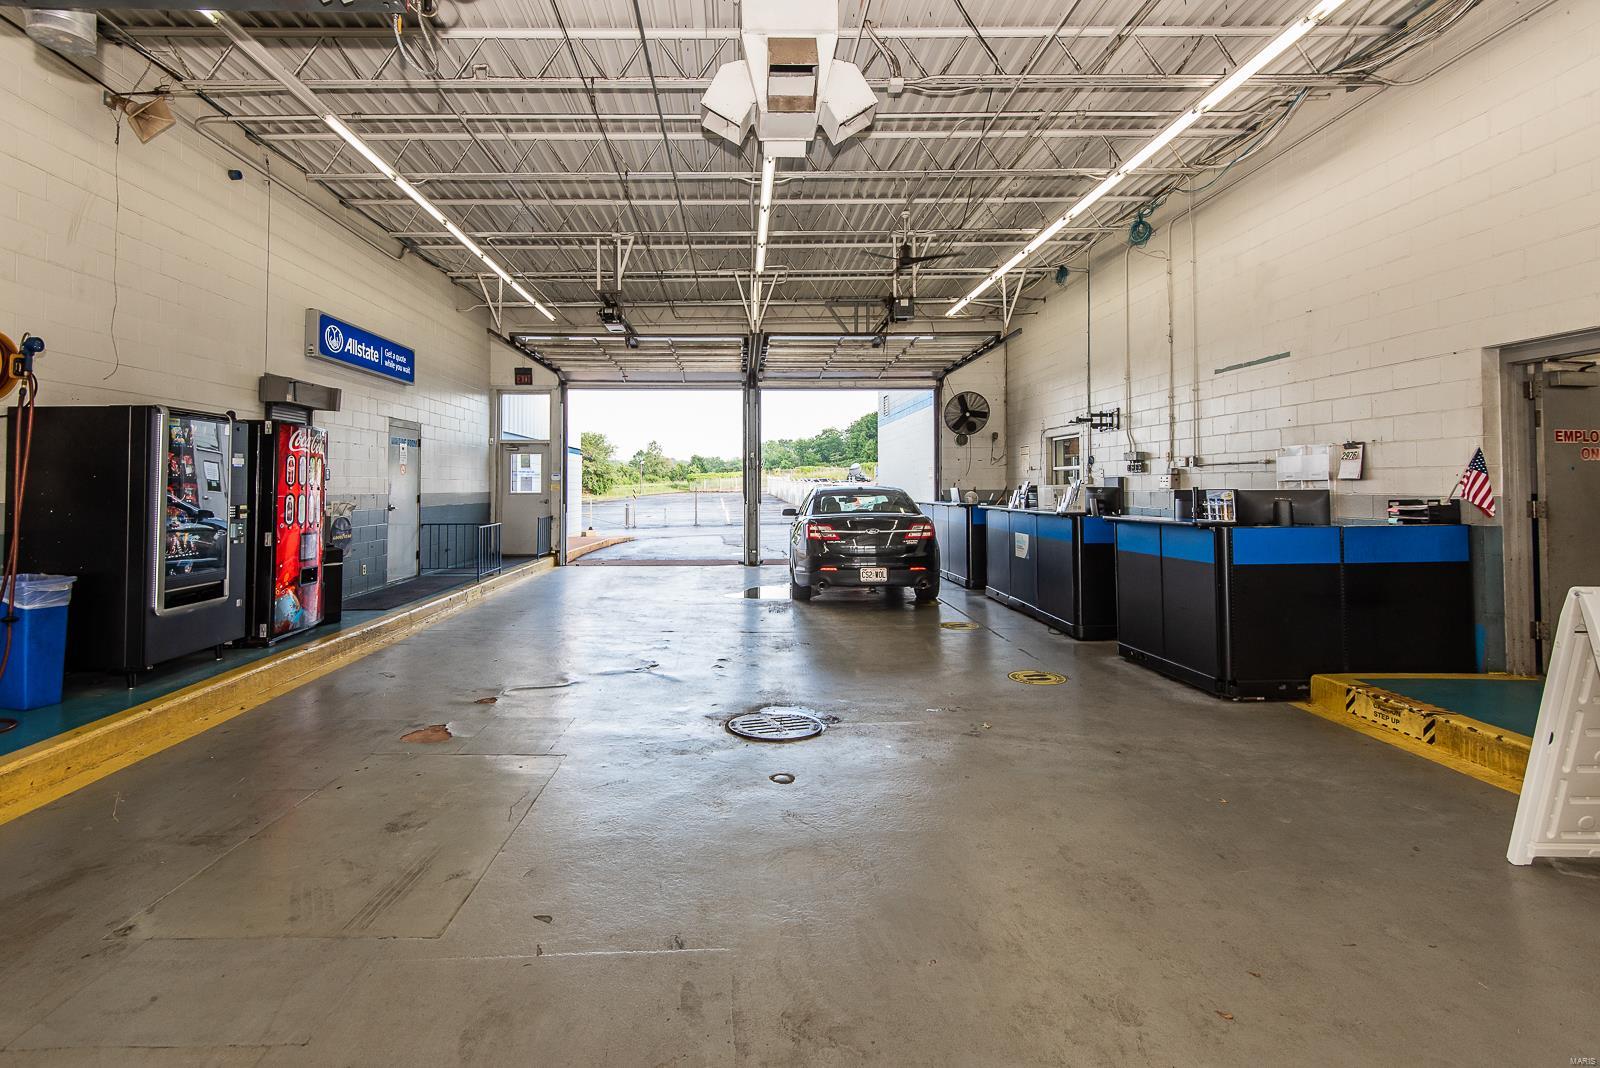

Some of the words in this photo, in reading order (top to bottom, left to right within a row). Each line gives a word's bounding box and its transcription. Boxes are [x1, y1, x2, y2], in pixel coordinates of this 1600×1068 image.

[344, 338, 379, 362] Allstate
[384, 348, 393, 359] Get
[396, 354, 407, 364] quote
[384, 359, 396, 369] while
[395, 364, 403, 372] you
[1555, 430, 1600, 443] EMPLO
[1373, 710, 1390, 721] STEP
[1391, 717, 1401, 725] UP
